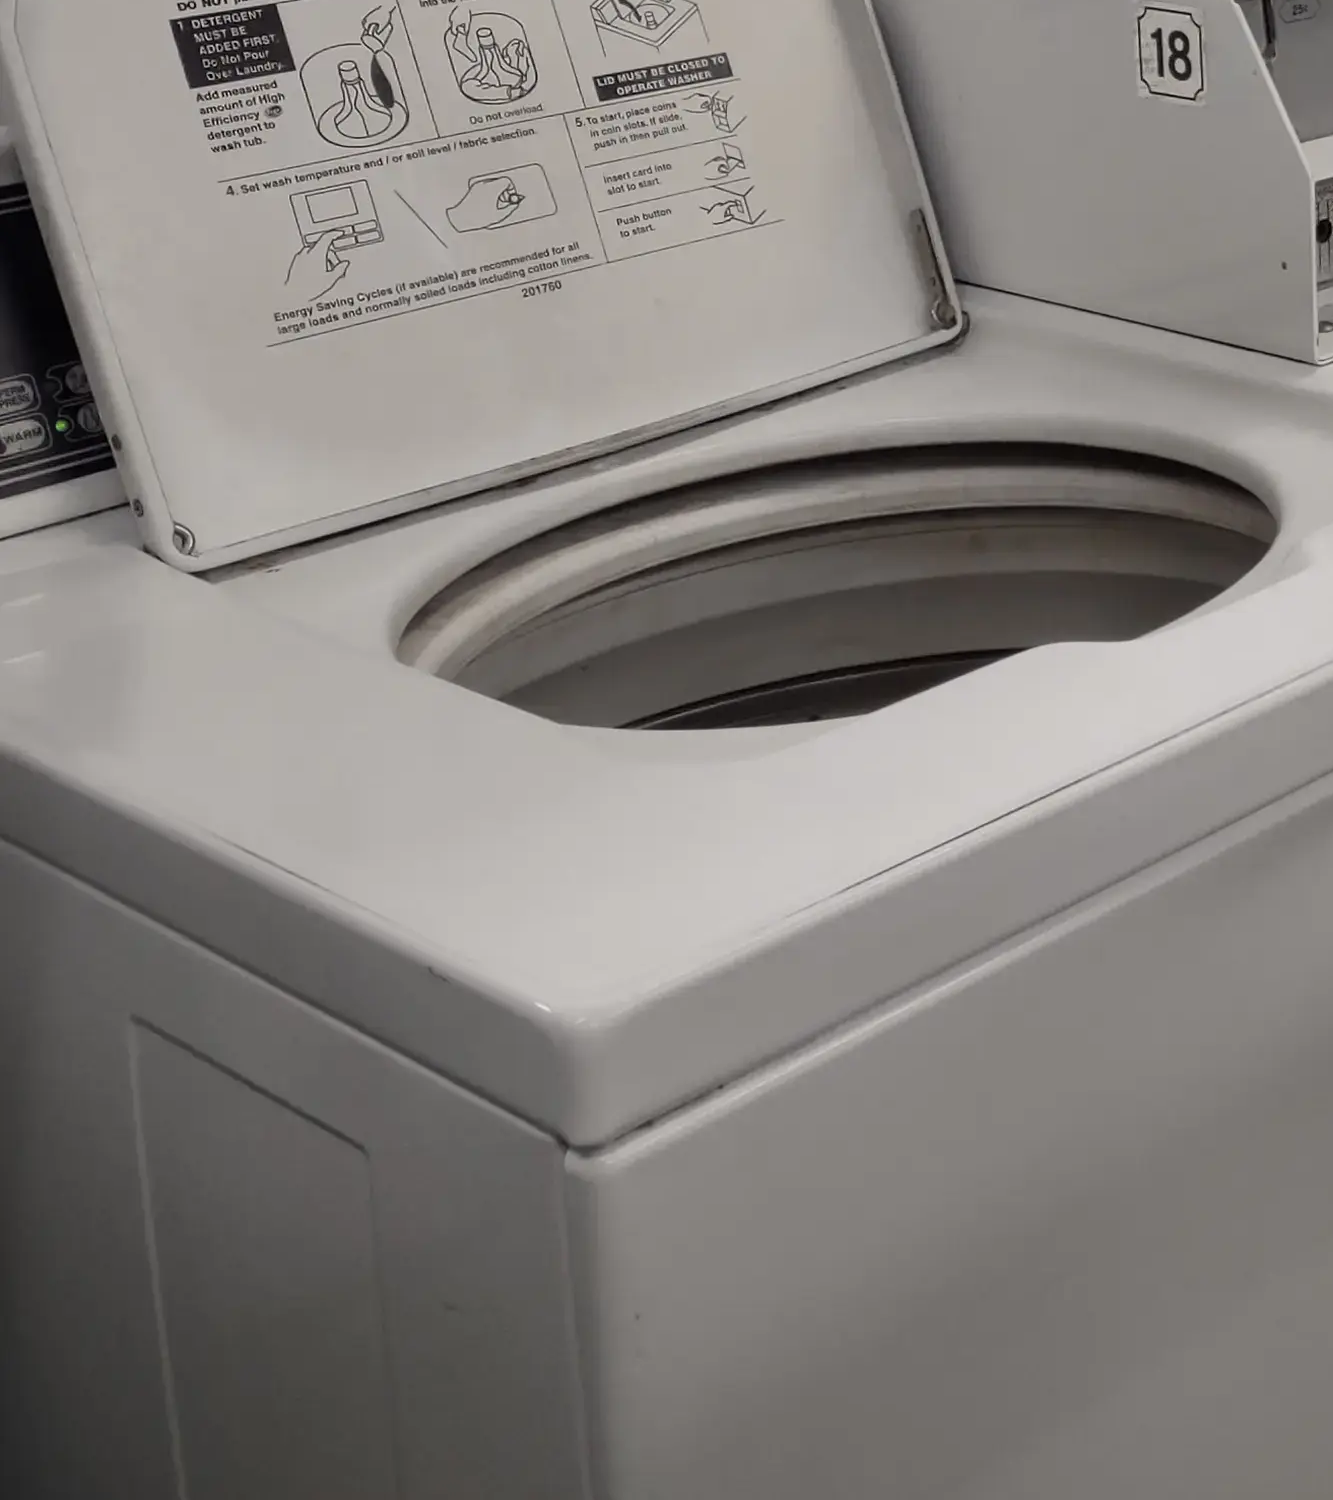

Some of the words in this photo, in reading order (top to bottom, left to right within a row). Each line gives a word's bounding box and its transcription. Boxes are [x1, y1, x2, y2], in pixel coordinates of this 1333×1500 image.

[176, 0, 197, 12] DO
[191, 8, 262, 29] DETERGENT
[193, 28, 227, 43] MUST
[230, 25, 247, 37] BE
[200, 40, 241, 55] ADDED
[1150, 28, 1192, 81] 18
[202, 58, 218, 68] Do
[243, 49, 269, 61] Pour
[596, 77, 615, 86] LID
[617, 69, 648, 83] MUST
[650, 66, 666, 77] BE
[667, 58, 709, 73] CLOSED
[711, 56, 725, 64] TO
[196, 90, 220, 102] Add
[221, 79, 278, 98] measured
[617, 78, 666, 96] OPERATE
[667, 70, 713, 86] WASHER
[200, 99, 244, 115] amount
[245, 96, 257, 107] of
[258, 92, 285, 105] High
[585, 116, 599, 125] To
[625, 106, 650, 119] place
[652, 101, 677, 112] coins
[203, 111, 260, 128] Efficiency
[469, 115, 484, 125] Do
[485, 111, 503, 122] not
[207, 122, 263, 141] detergent
[263, 121, 276, 130] to
[590, 129, 600, 138] in
[601, 124, 622, 136] coin
[593, 137, 617, 151] push
[619, 136, 628, 144] in
[629, 132, 650, 142] then
[652, 126, 670, 139] pull
[210, 140, 242, 153] wash
[240, 182, 260, 194] Set
[262, 175, 292, 189] wash
[294, 163, 361, 183] temperature
[363, 157, 384, 169] and
[392, 154, 403, 163] or
[632, 165, 653, 177] card
[654, 163, 672, 173] into
[607, 184, 625, 195] slot
[616, 214, 641, 226] Push
[642, 208, 672, 221] button
[620, 230, 630, 238] to
[273, 306, 313, 322] Energy
[316, 296, 355, 312] Saving
[356, 287, 393, 302] Cycles
[395, 281, 406, 295] (if
[409, 270, 459, 290] available)
[461, 267, 477, 277] are
[479, 248, 550, 273] recommended
[551, 246, 565, 255] for
[568, 241, 580, 252] all
[308, 312, 340, 327] loads
[342, 306, 363, 319] and
[365, 295, 411, 314] normally
[414, 286, 446, 301] soiled
[478, 268, 526, 286] including
[527, 260, 559, 274] cotton
[4, 428, 41, 442] WARM
